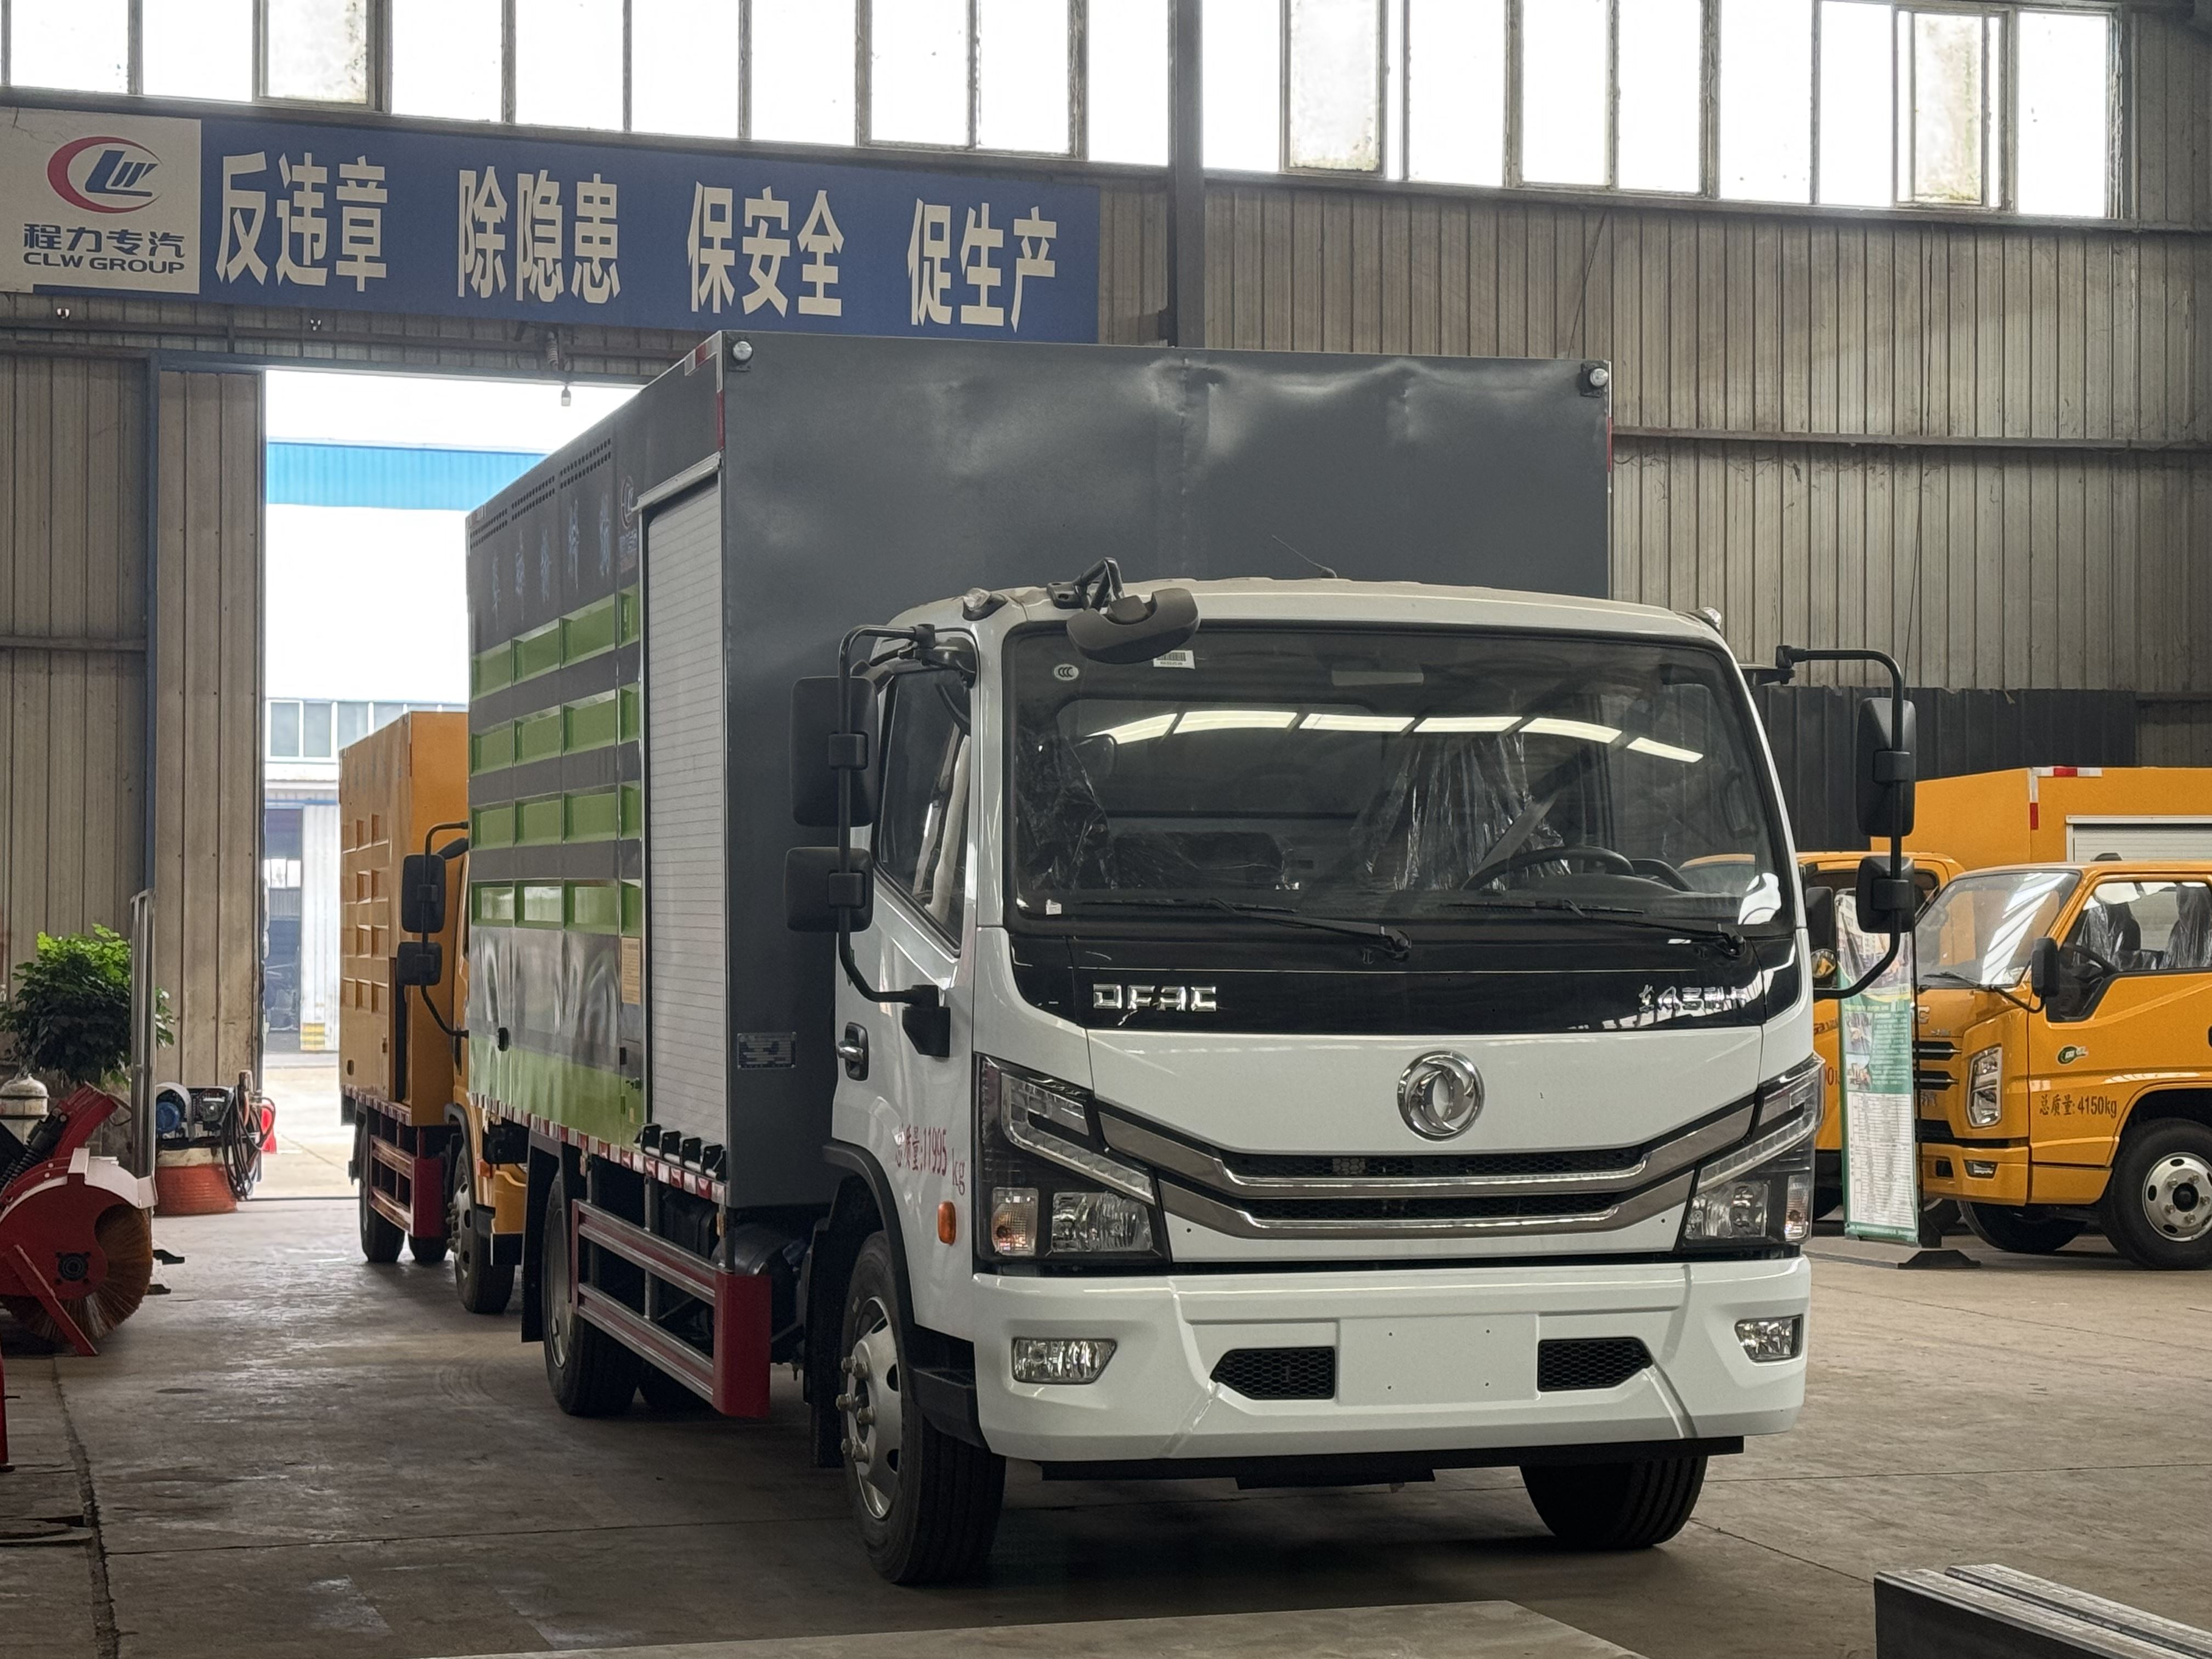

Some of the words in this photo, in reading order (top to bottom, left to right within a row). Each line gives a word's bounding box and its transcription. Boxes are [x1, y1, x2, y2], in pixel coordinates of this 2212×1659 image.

[22, 222, 185, 258] 程力专汽
[216, 151, 388, 292] 反违章
[458, 165, 621, 304] 除隐患
[687, 180, 845, 318] 保安全
[907, 198, 1058, 332] 促生产
[22, 251, 83, 268] CLW
[89, 257, 185, 274] GROUP
[1092, 983, 1217, 1012] DFAC
